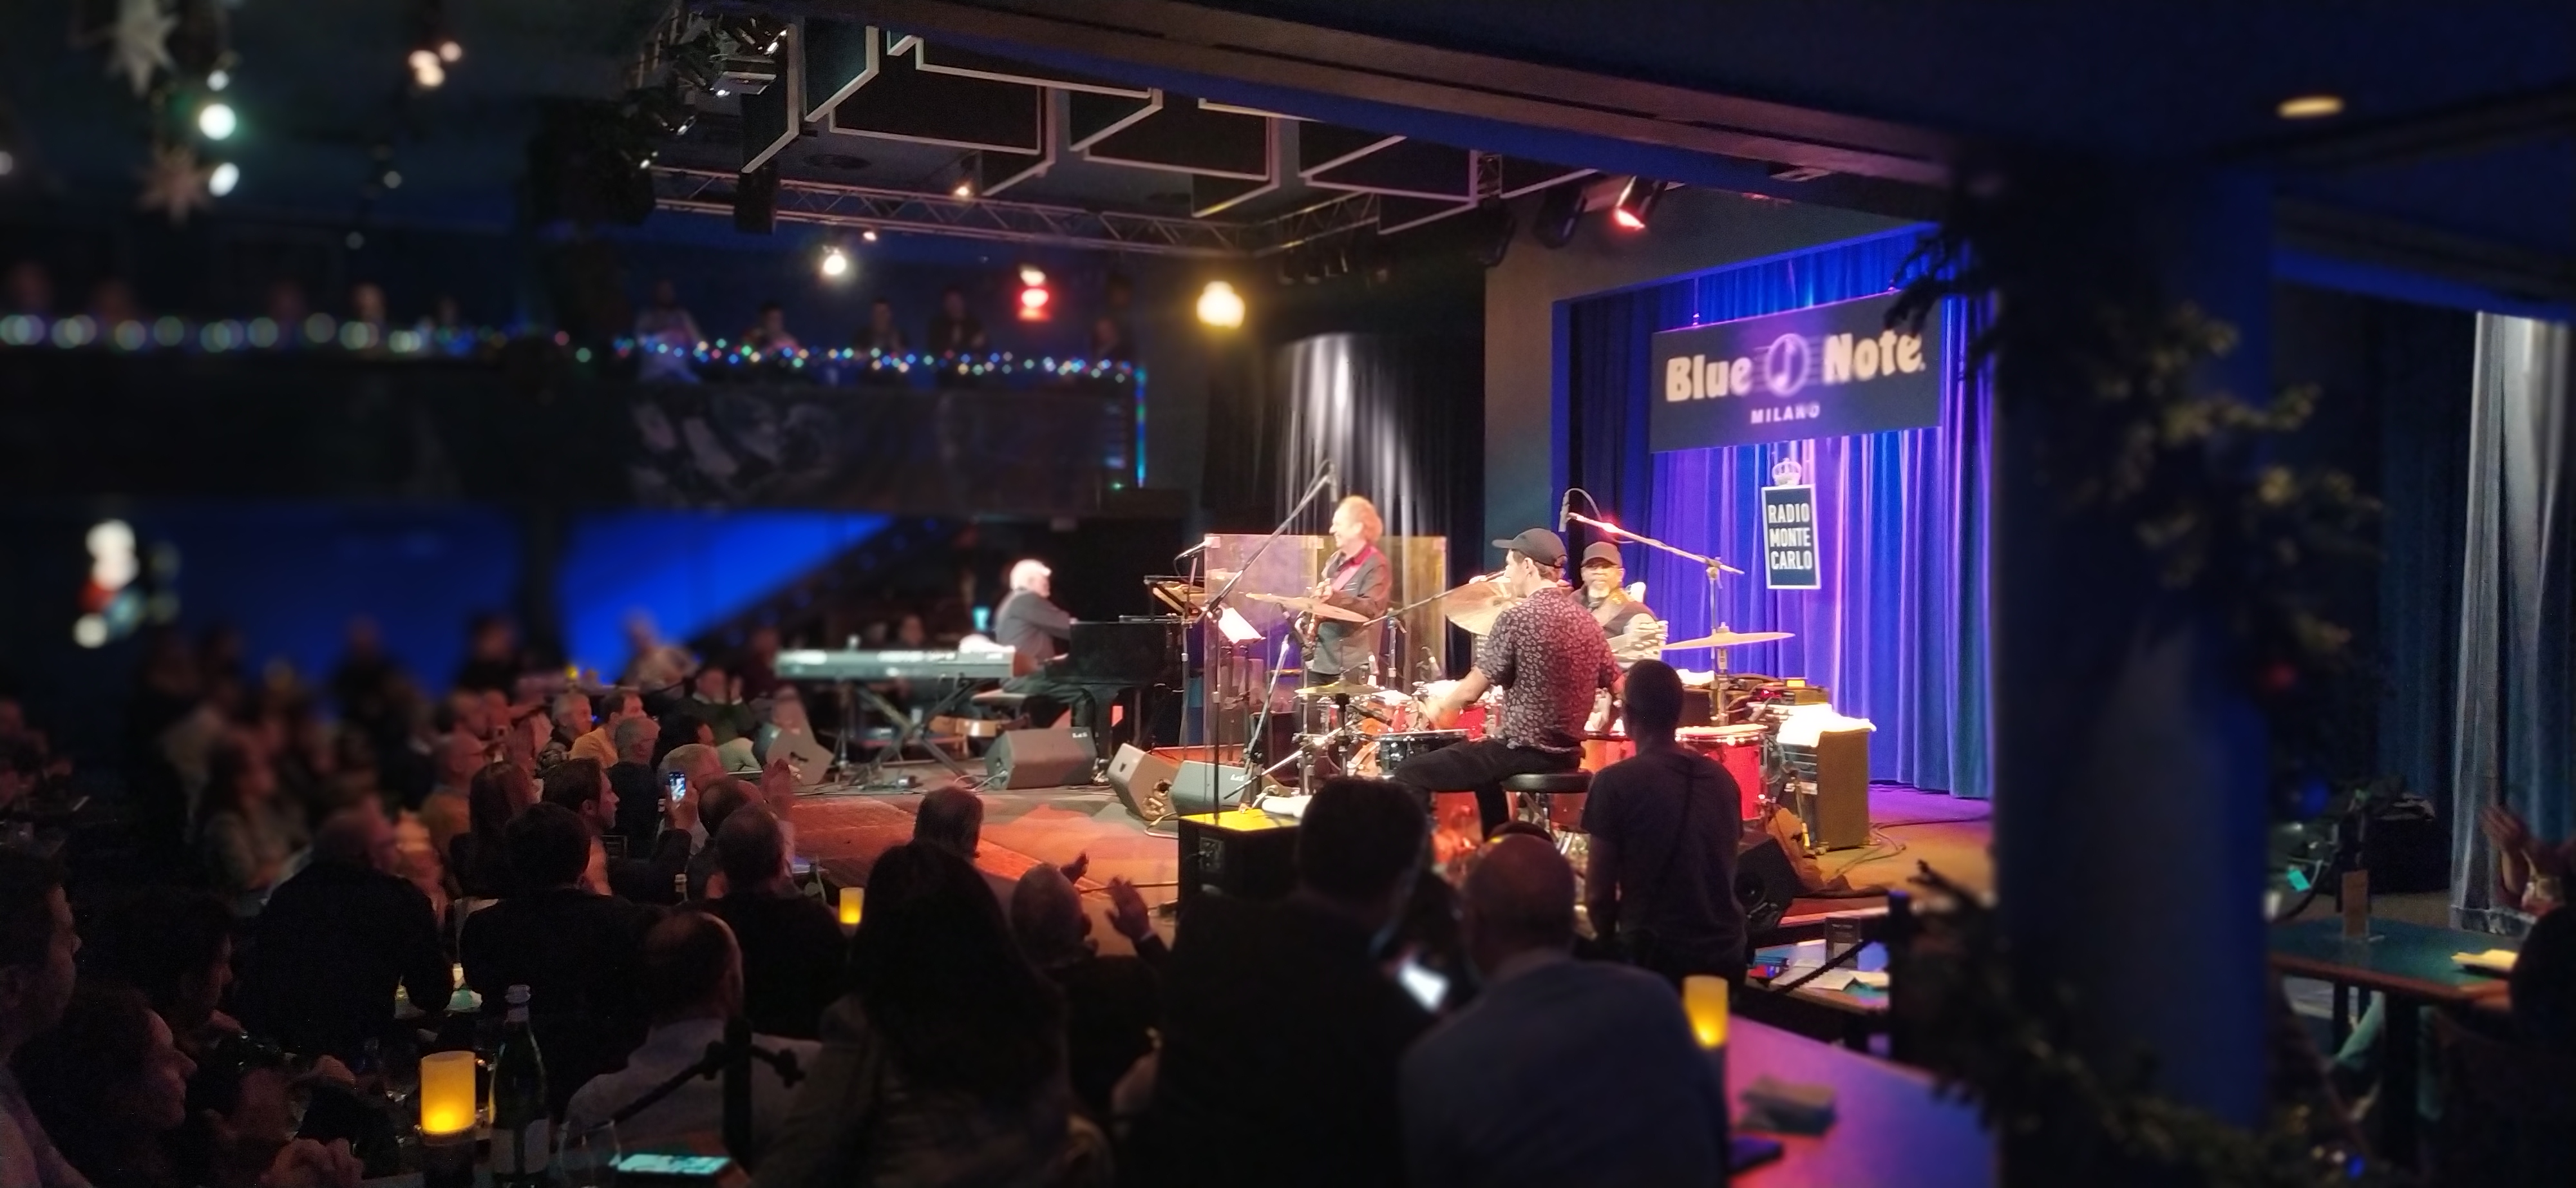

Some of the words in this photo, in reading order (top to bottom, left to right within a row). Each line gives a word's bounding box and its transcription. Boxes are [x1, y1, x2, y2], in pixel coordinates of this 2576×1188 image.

[1666, 354, 1752, 402] Blue
[1823, 329, 1923, 384] Note
[1751, 403, 1820, 424] MILANO
[1768, 503, 1810, 523] RADIO
[1769, 527, 1811, 547] MONTE
[1771, 550, 1813, 570] CARLO
